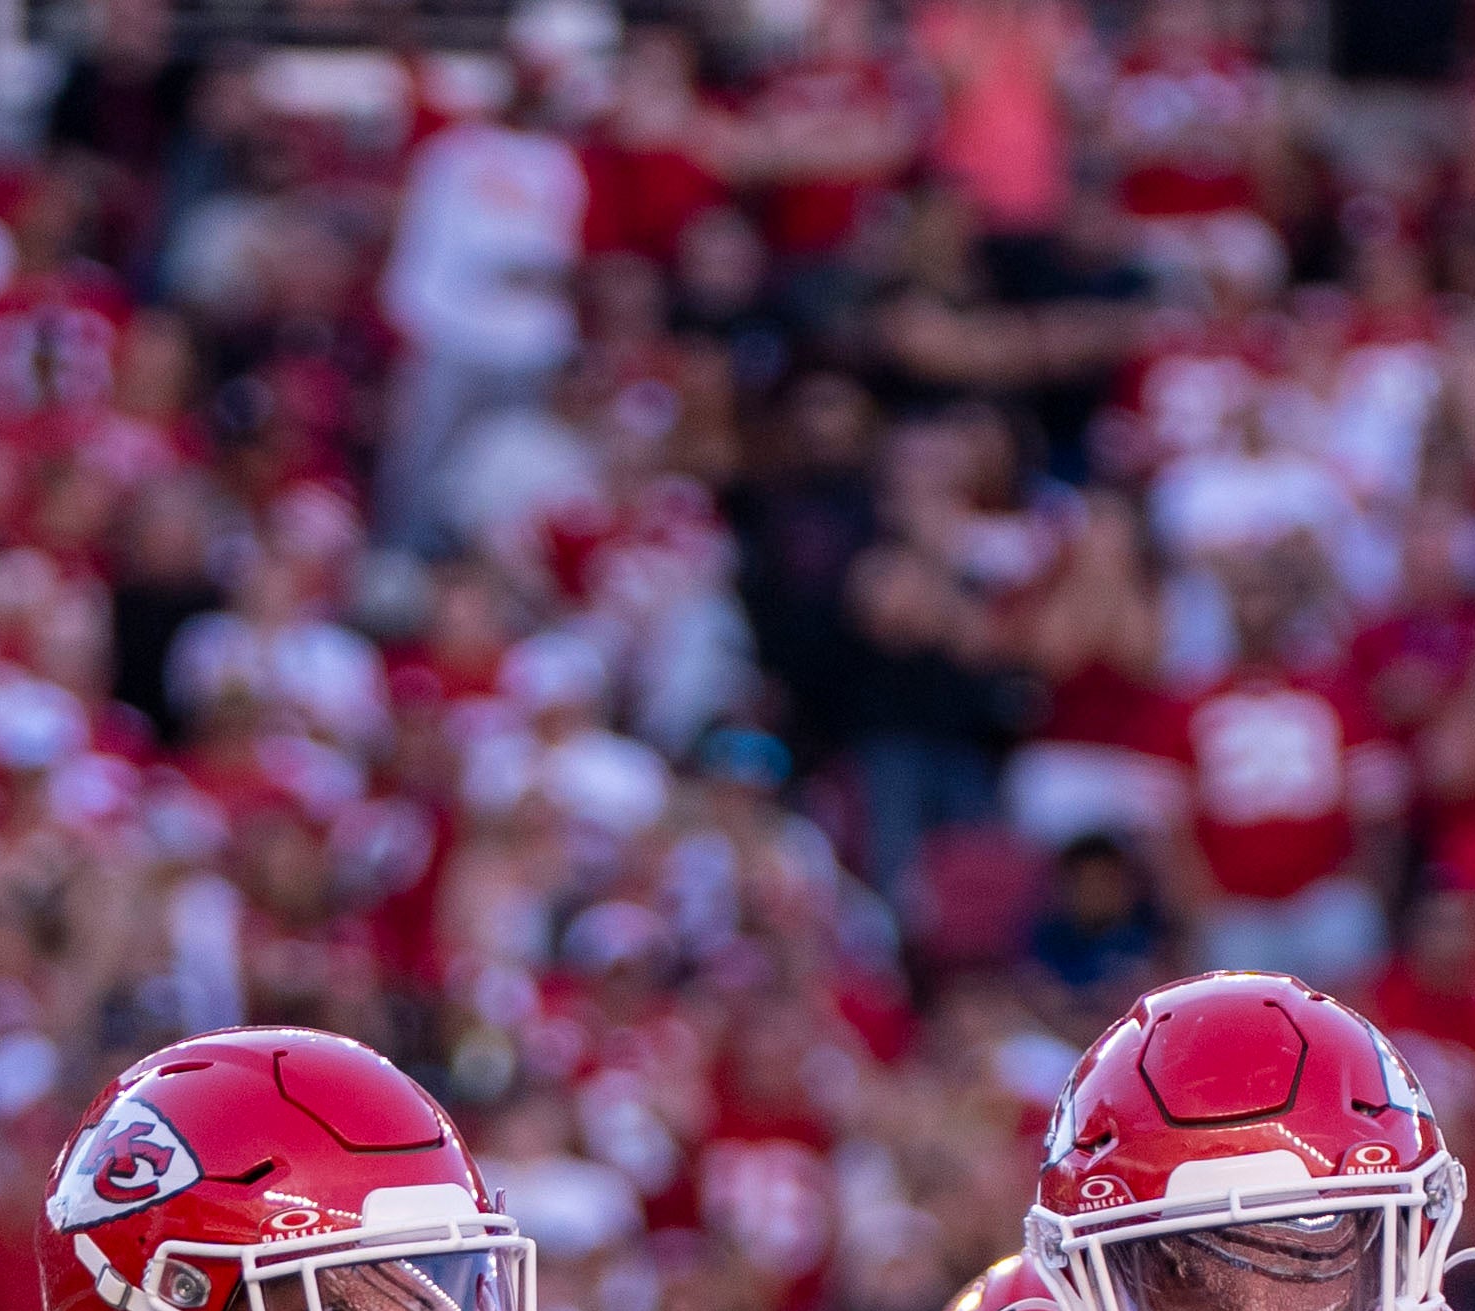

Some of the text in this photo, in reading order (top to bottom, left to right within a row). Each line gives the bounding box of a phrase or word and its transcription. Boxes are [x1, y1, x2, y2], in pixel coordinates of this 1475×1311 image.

[1346, 1164, 1399, 1175] OAKLEY
[1078, 1195, 1127, 1212] OAKLEY
[262, 1224, 334, 1243] OAKLEY
